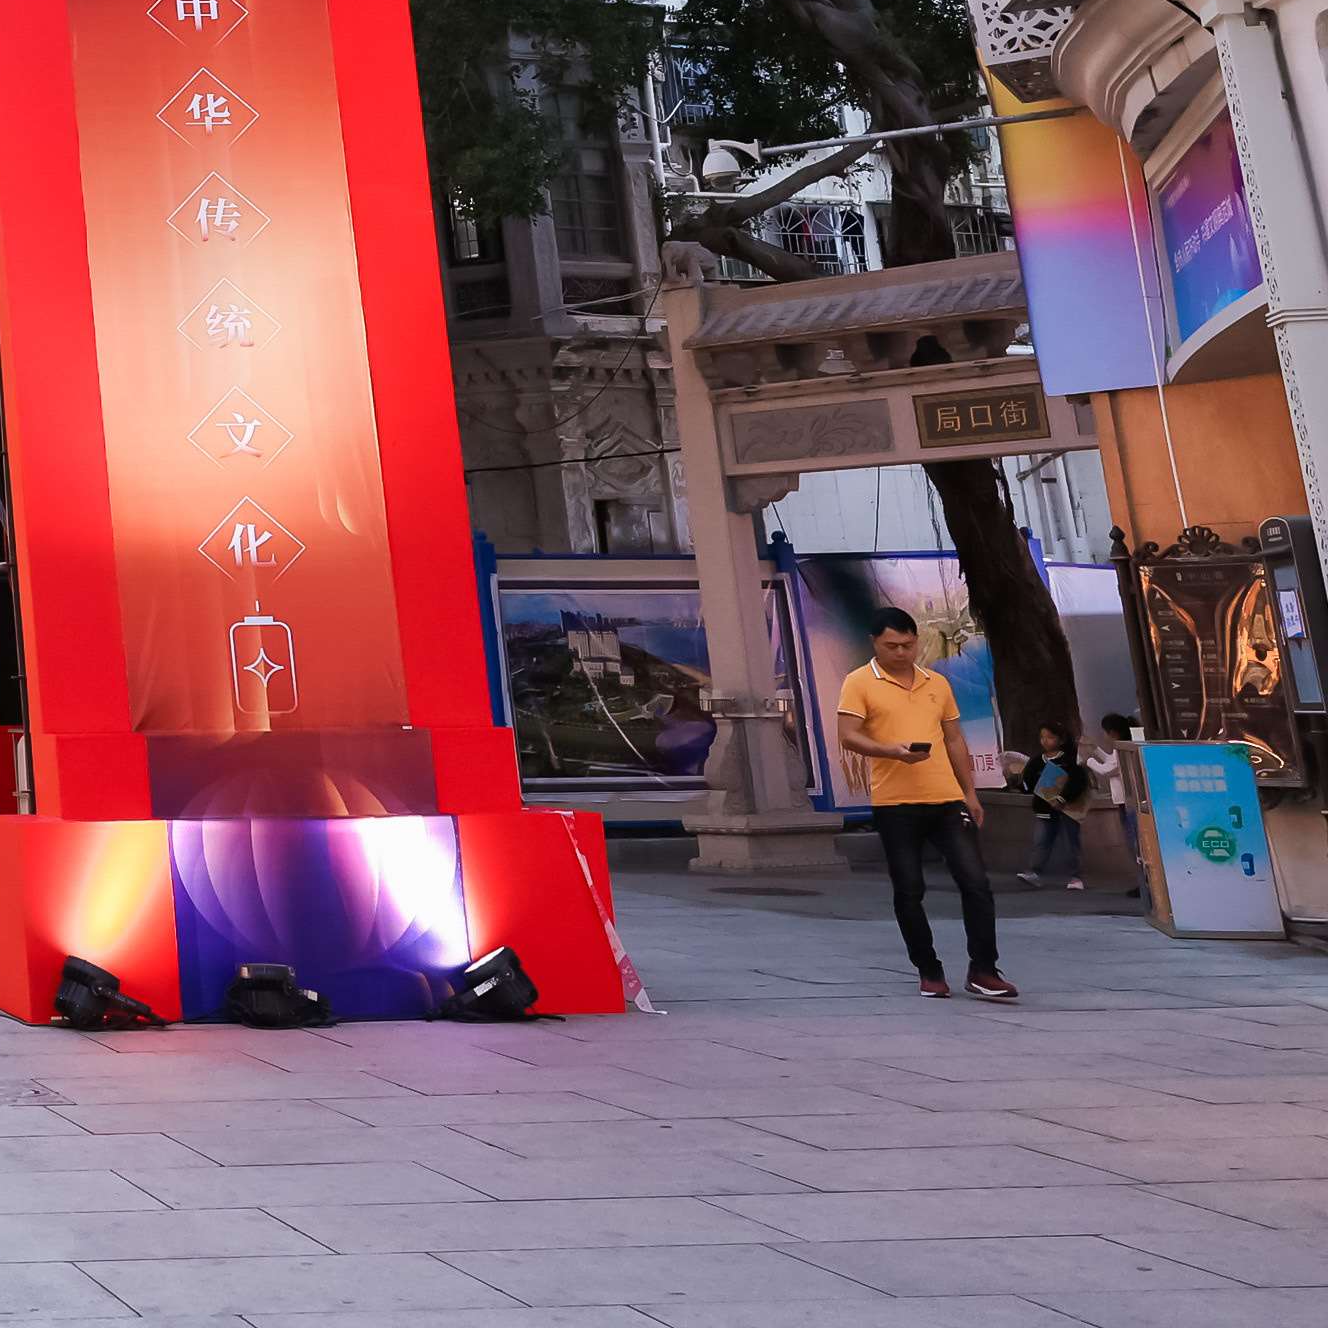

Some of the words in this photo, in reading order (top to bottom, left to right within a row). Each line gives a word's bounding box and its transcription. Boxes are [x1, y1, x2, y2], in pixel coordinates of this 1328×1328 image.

[936, 400, 1028, 432] 局口街
[1202, 840, 1230, 848] ECO
